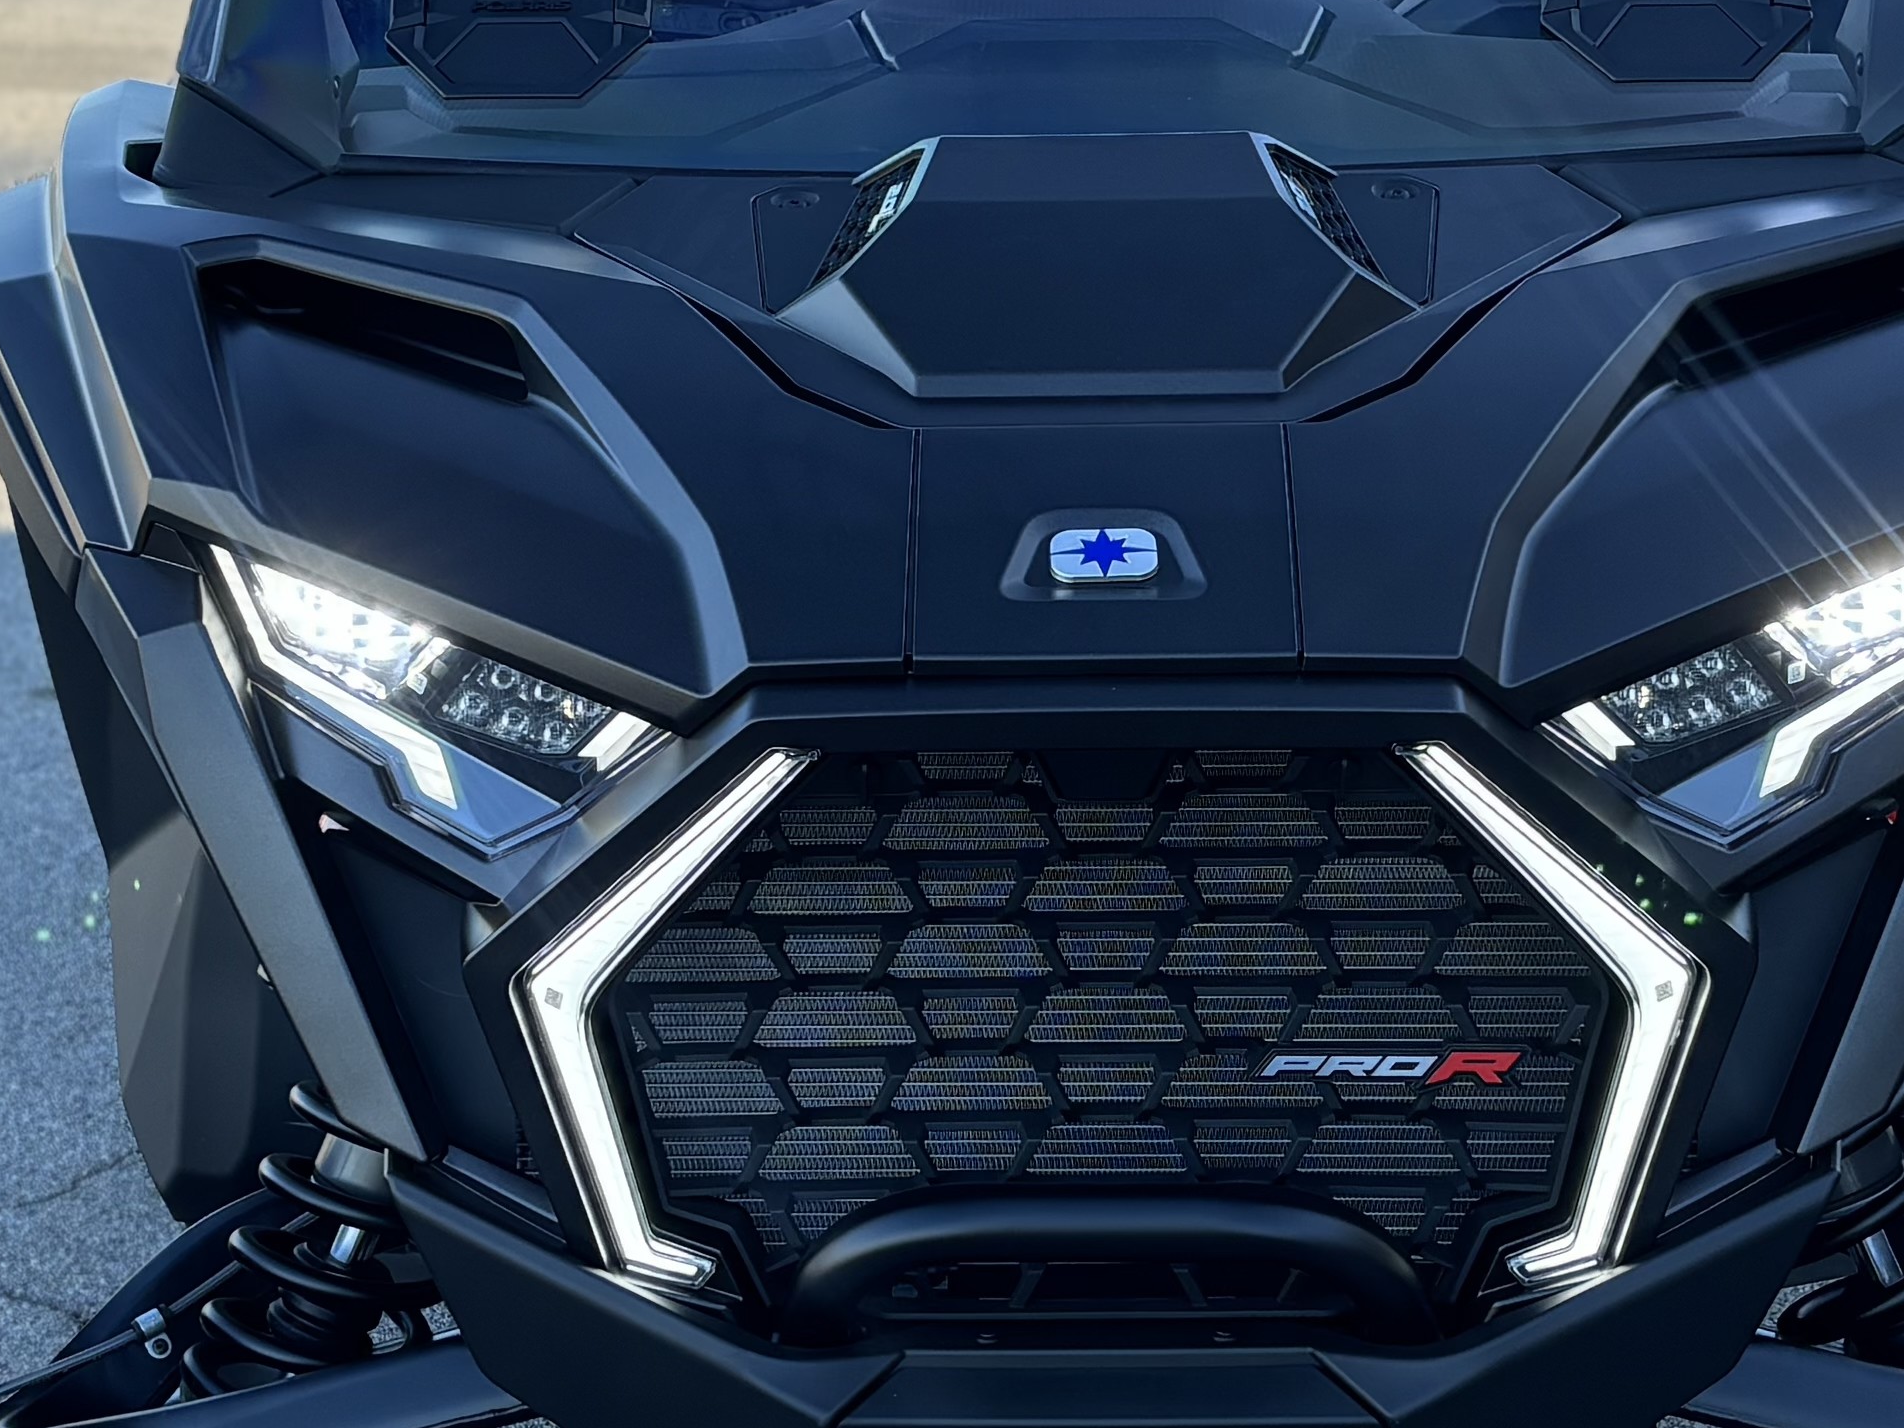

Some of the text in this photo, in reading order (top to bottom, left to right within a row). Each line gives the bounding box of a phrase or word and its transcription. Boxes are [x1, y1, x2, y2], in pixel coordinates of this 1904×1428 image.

[471, 0, 573, 13] POLARIS
[1259, 1051, 1523, 1085] PRO R
